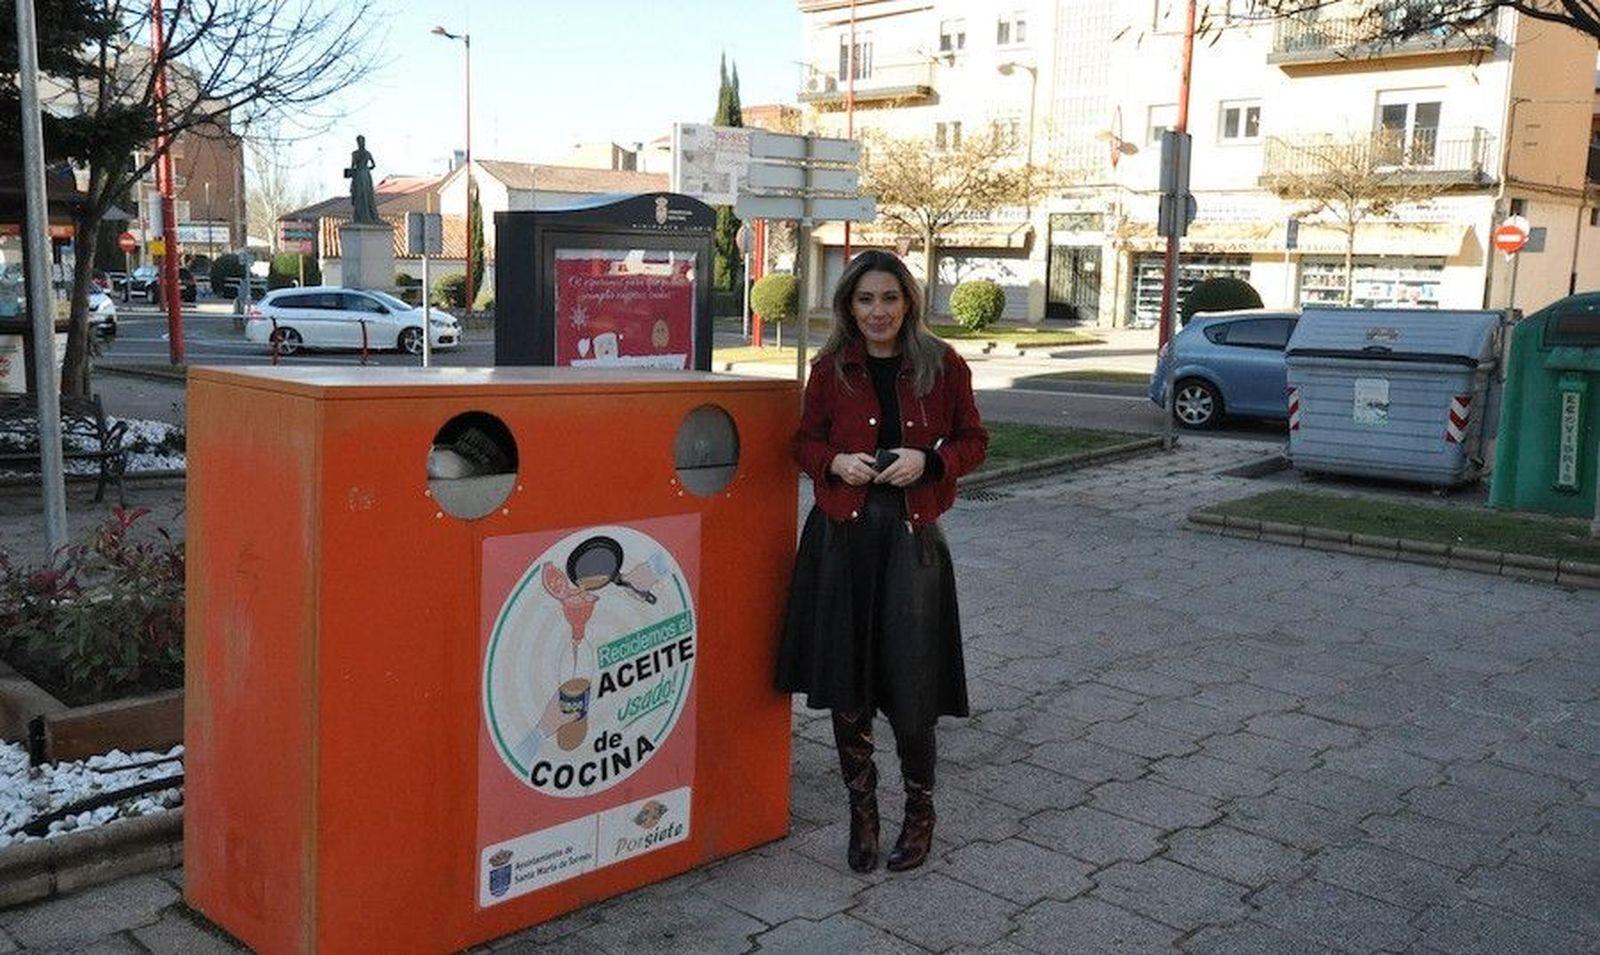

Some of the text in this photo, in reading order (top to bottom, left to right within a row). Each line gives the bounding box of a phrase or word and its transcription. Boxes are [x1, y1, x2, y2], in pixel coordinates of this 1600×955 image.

[600, 616, 691, 664] Reciclemos el
[597, 636, 694, 698] ACEITE
[531, 736, 655, 789] COCINA
[594, 731, 622, 753] de
